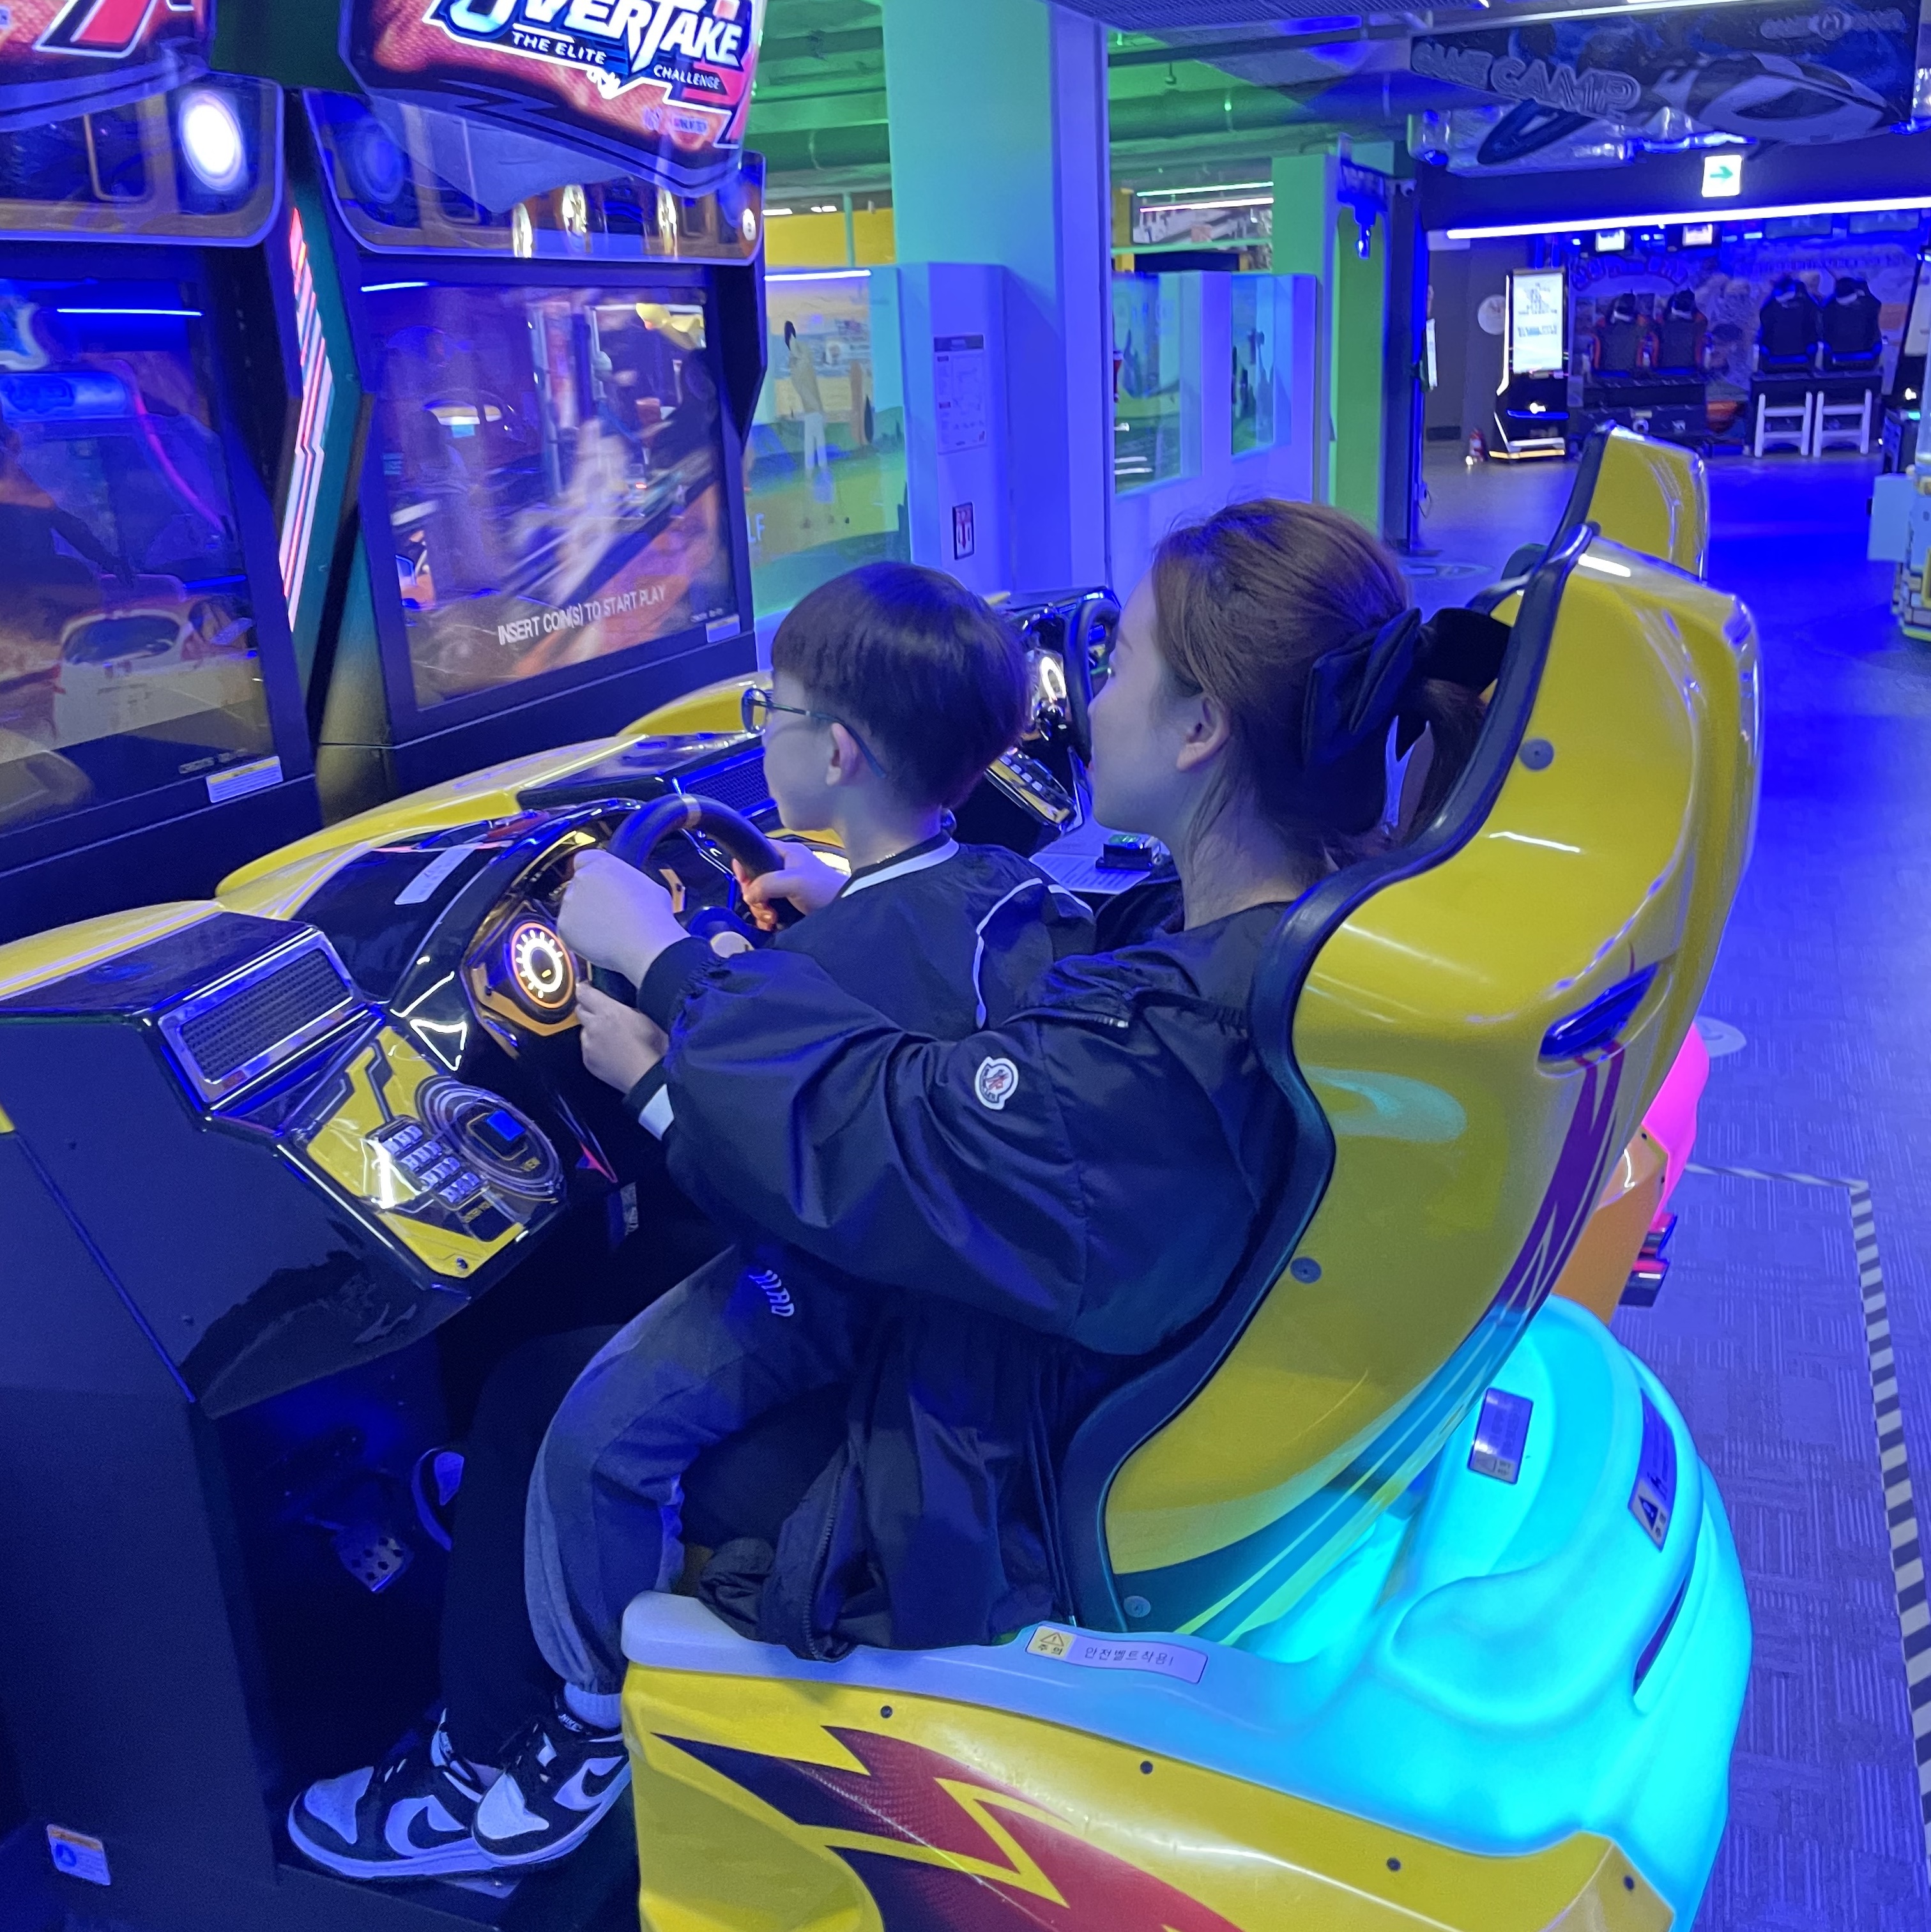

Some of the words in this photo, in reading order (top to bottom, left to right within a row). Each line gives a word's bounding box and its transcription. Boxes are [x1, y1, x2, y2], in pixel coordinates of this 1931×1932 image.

[512, 31, 551, 52] THE
[555, 42, 606, 65] ELITE
[653, 64, 720, 90] CHALLENGE
[498, 617, 540, 645] INSERT
[543, 602, 584, 633] COIN(S)
[584, 601, 601, 619] TO
[603, 591, 637, 617] START
[639, 584, 666, 606] PLAY
